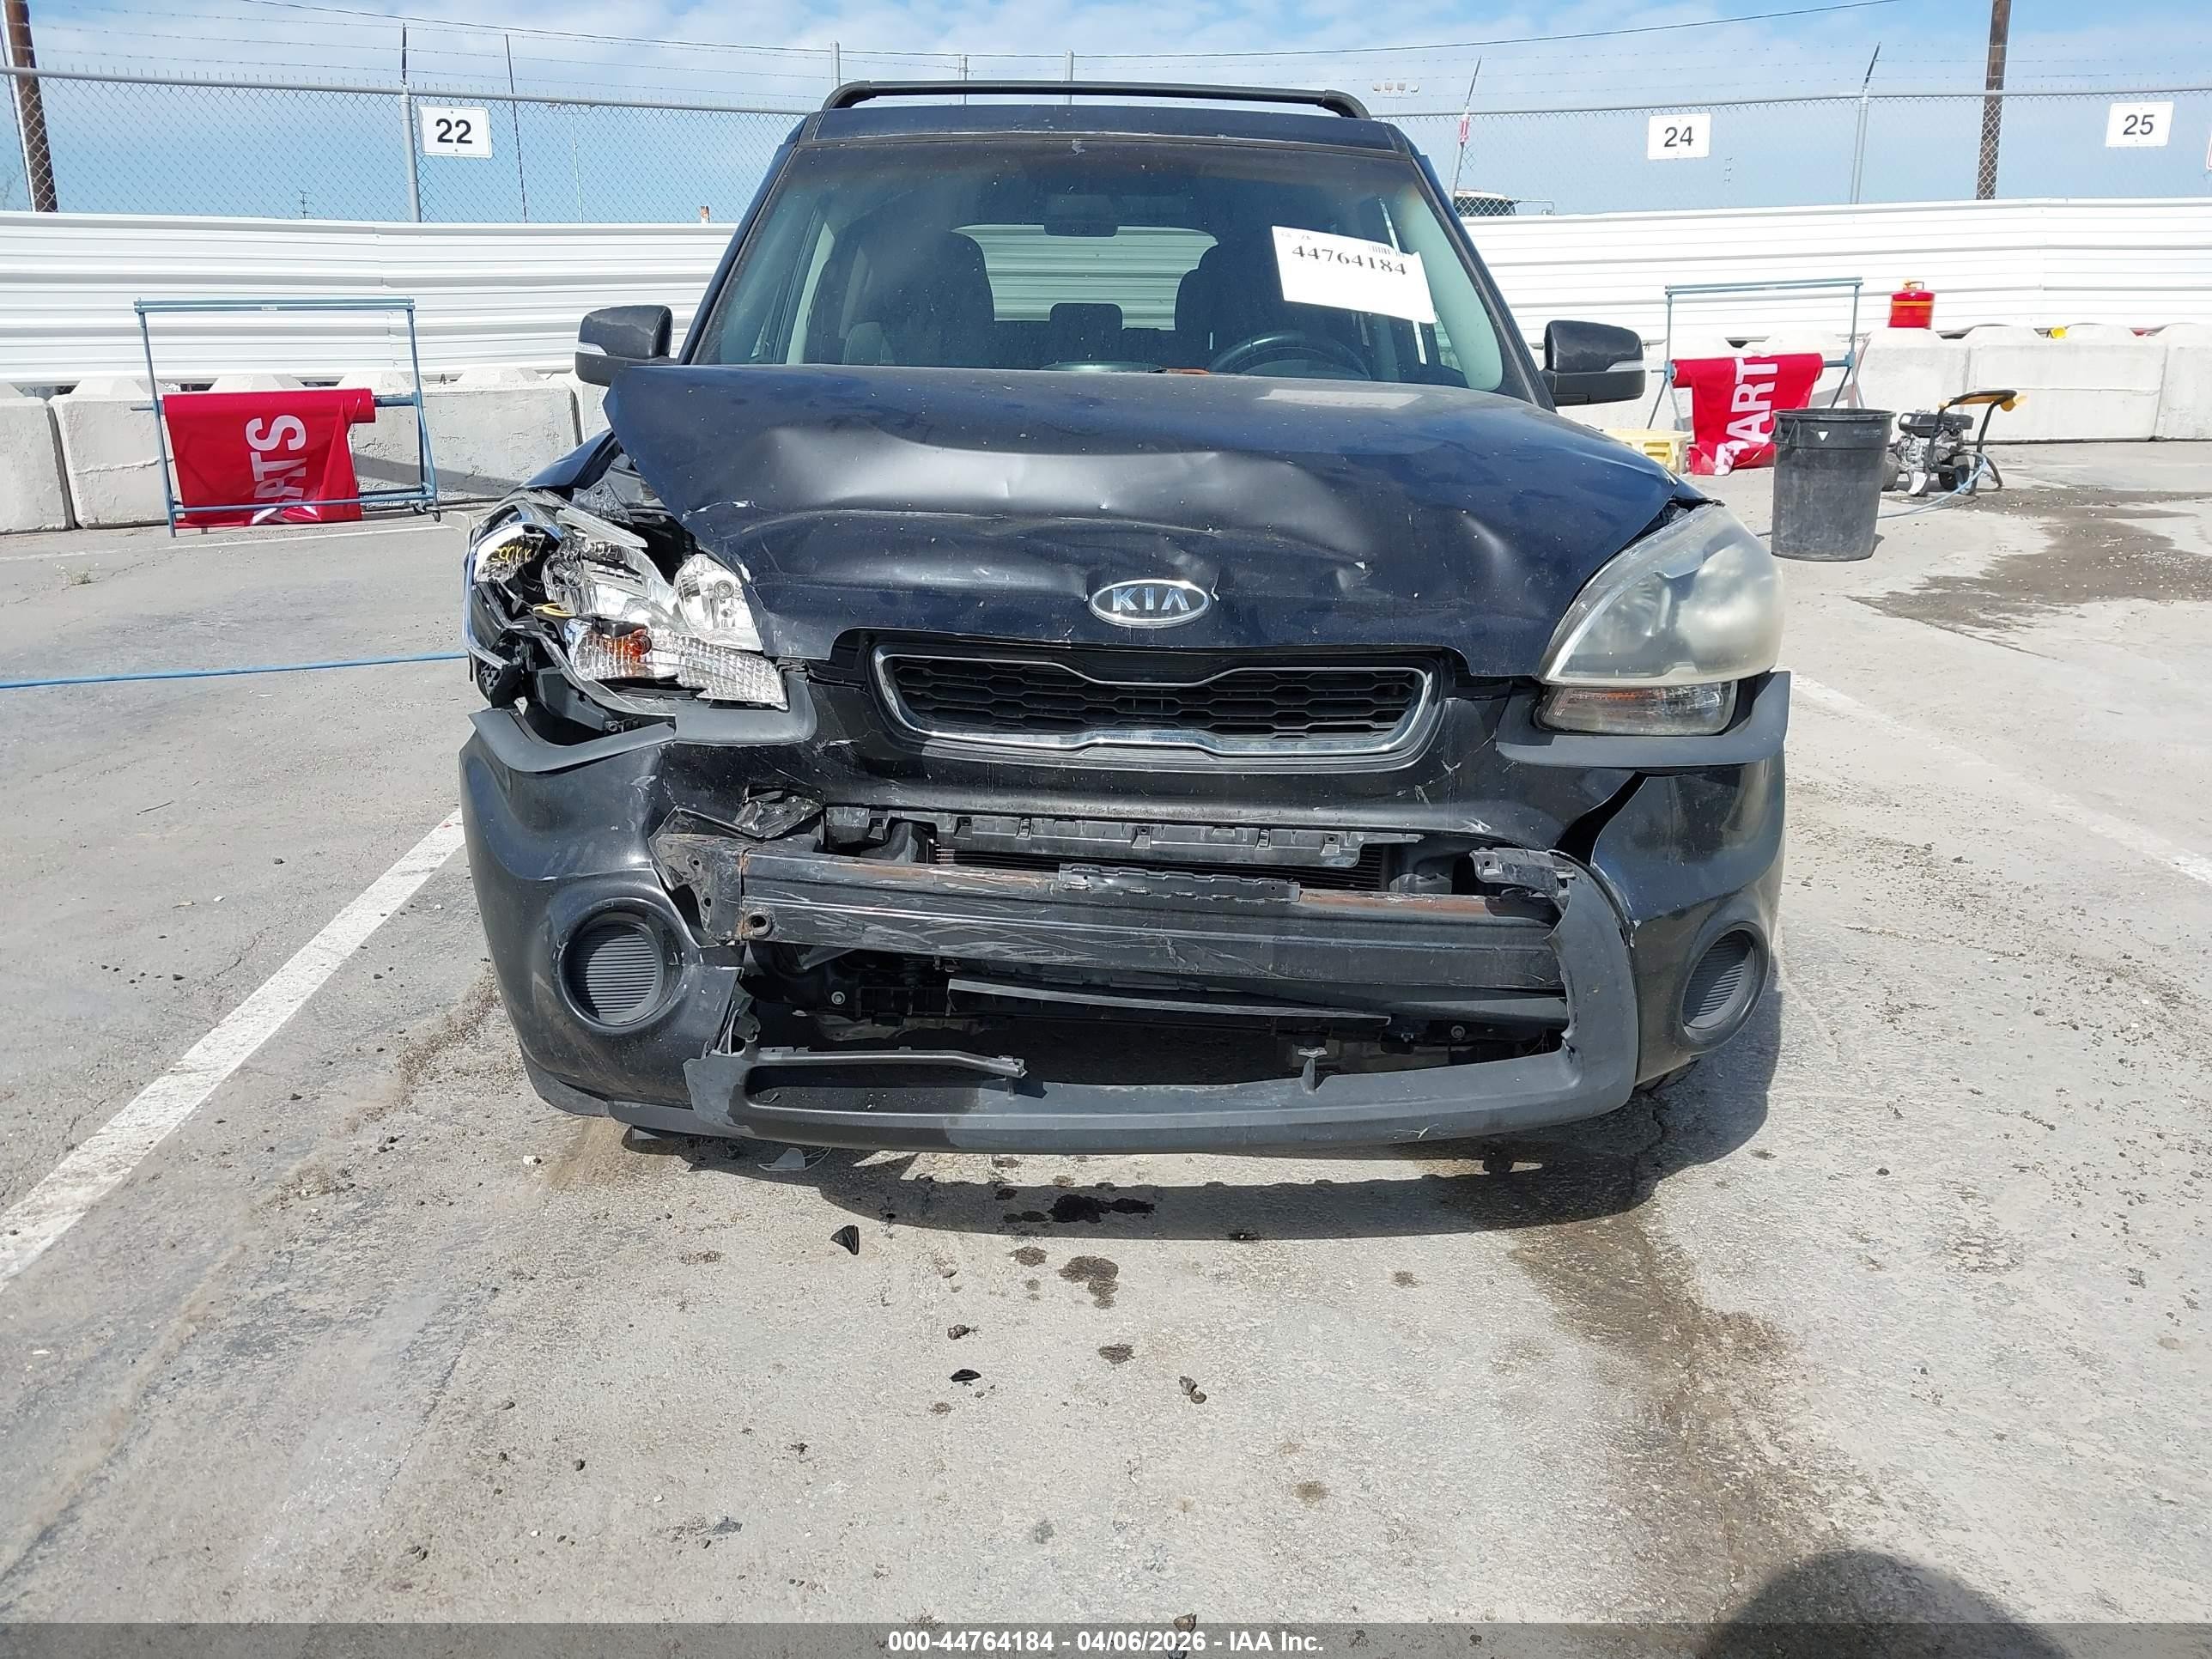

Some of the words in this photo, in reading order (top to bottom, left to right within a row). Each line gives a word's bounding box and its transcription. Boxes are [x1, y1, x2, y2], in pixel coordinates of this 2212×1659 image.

[435, 118, 472, 144] 22
[1664, 125, 1693, 147] 24
[2123, 114, 2154, 135] 25
[1291, 245, 1407, 275] 44764184
[1112, 587, 1191, 611] KIA
